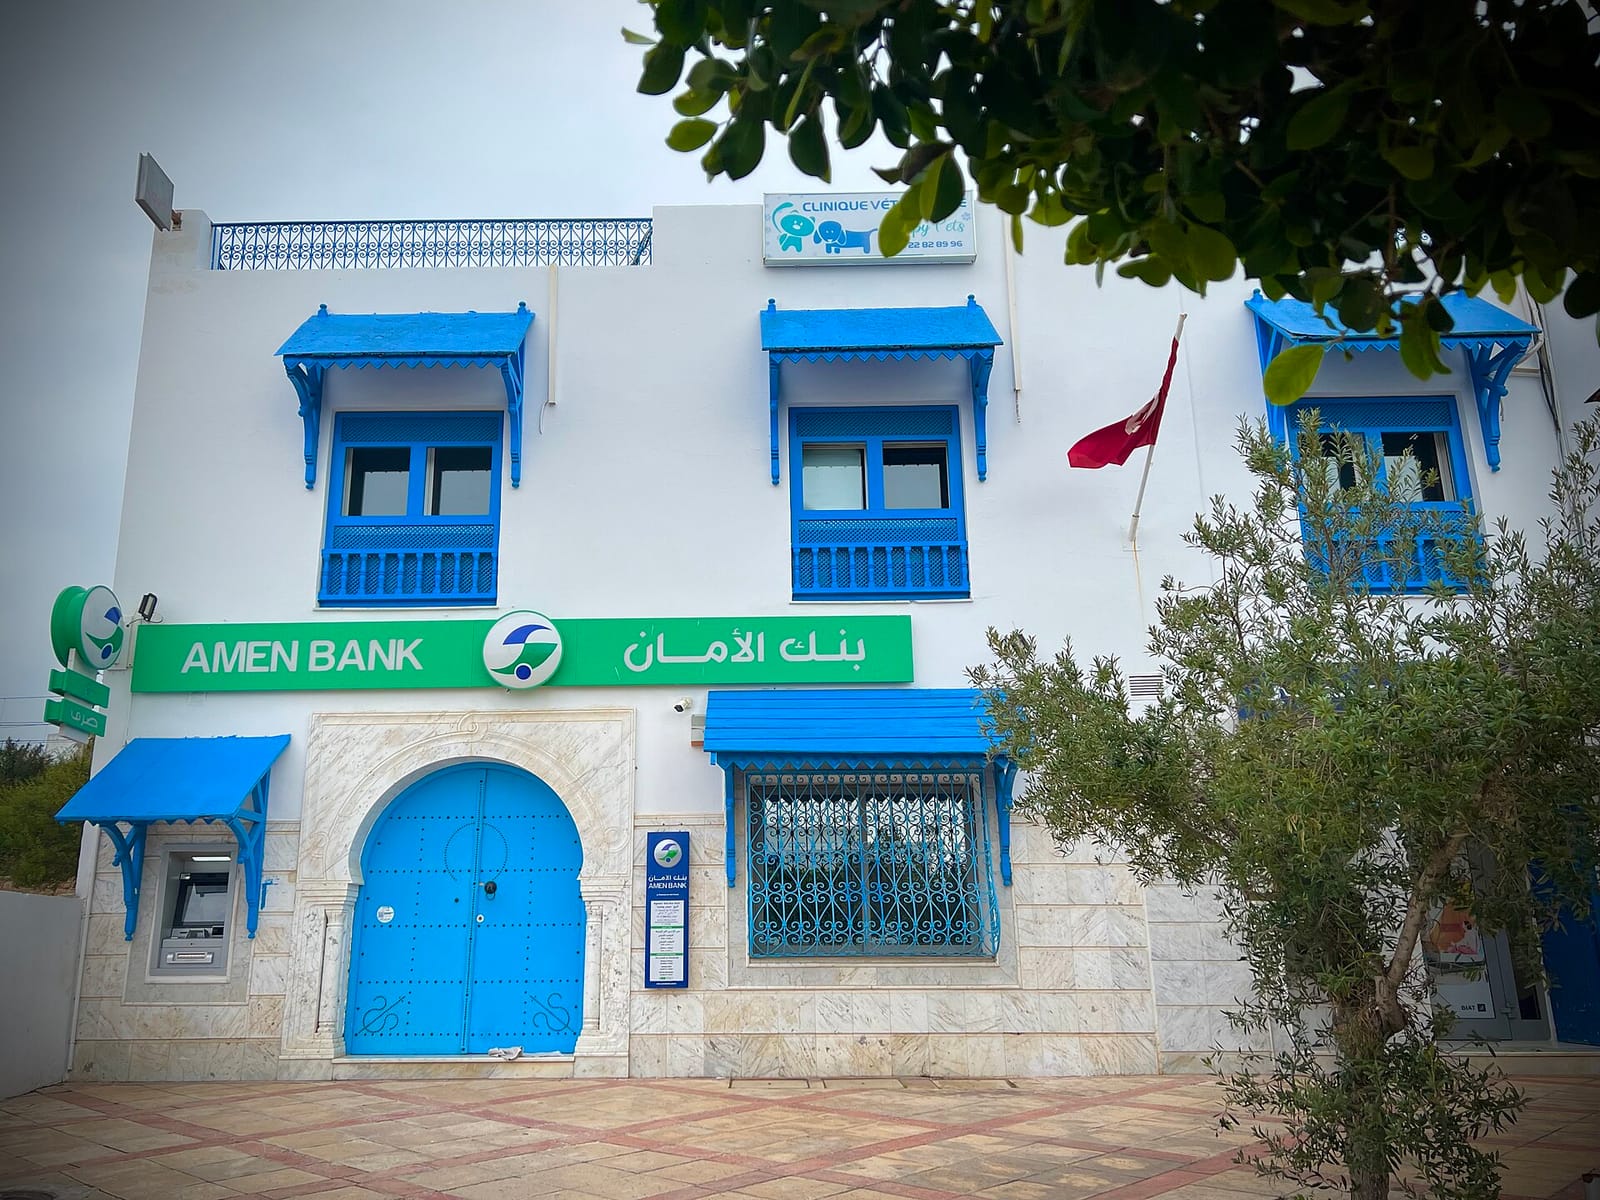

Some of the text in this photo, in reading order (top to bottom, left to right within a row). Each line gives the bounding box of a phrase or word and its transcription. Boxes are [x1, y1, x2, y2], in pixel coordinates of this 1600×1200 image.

[802, 200, 869, 212] CLINIQUE
[936, 240, 949, 248] 89
[181, 638, 424, 674] AMEN BANK
[623, 627, 866, 673] بنك الأمان
